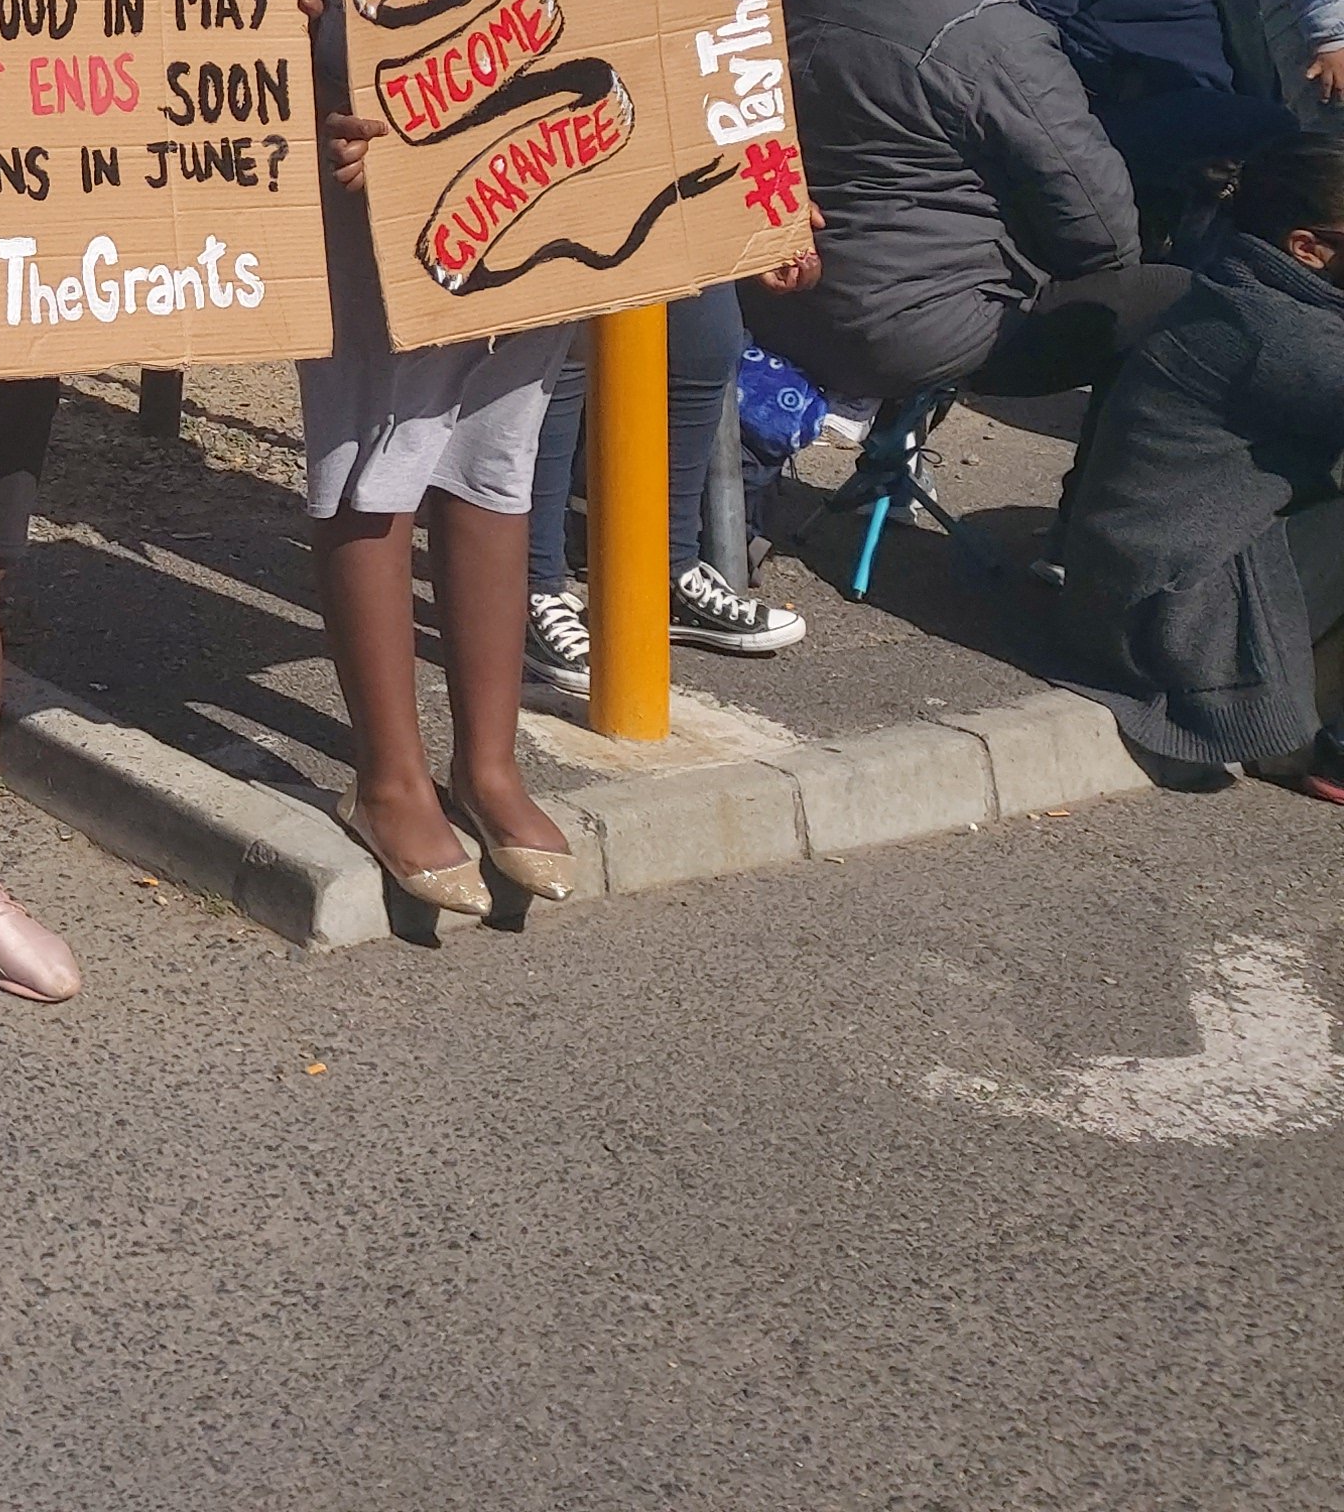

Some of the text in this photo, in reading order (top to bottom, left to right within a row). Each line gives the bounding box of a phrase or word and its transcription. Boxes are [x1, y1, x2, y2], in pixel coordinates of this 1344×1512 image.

[29, 52, 140, 117] ENDS
[158, 58, 291, 126] SOON
[82, 146, 119, 192] IN
[145, 134, 288, 191] JUNE?
[434, 100, 622, 270] GUARANTEE
